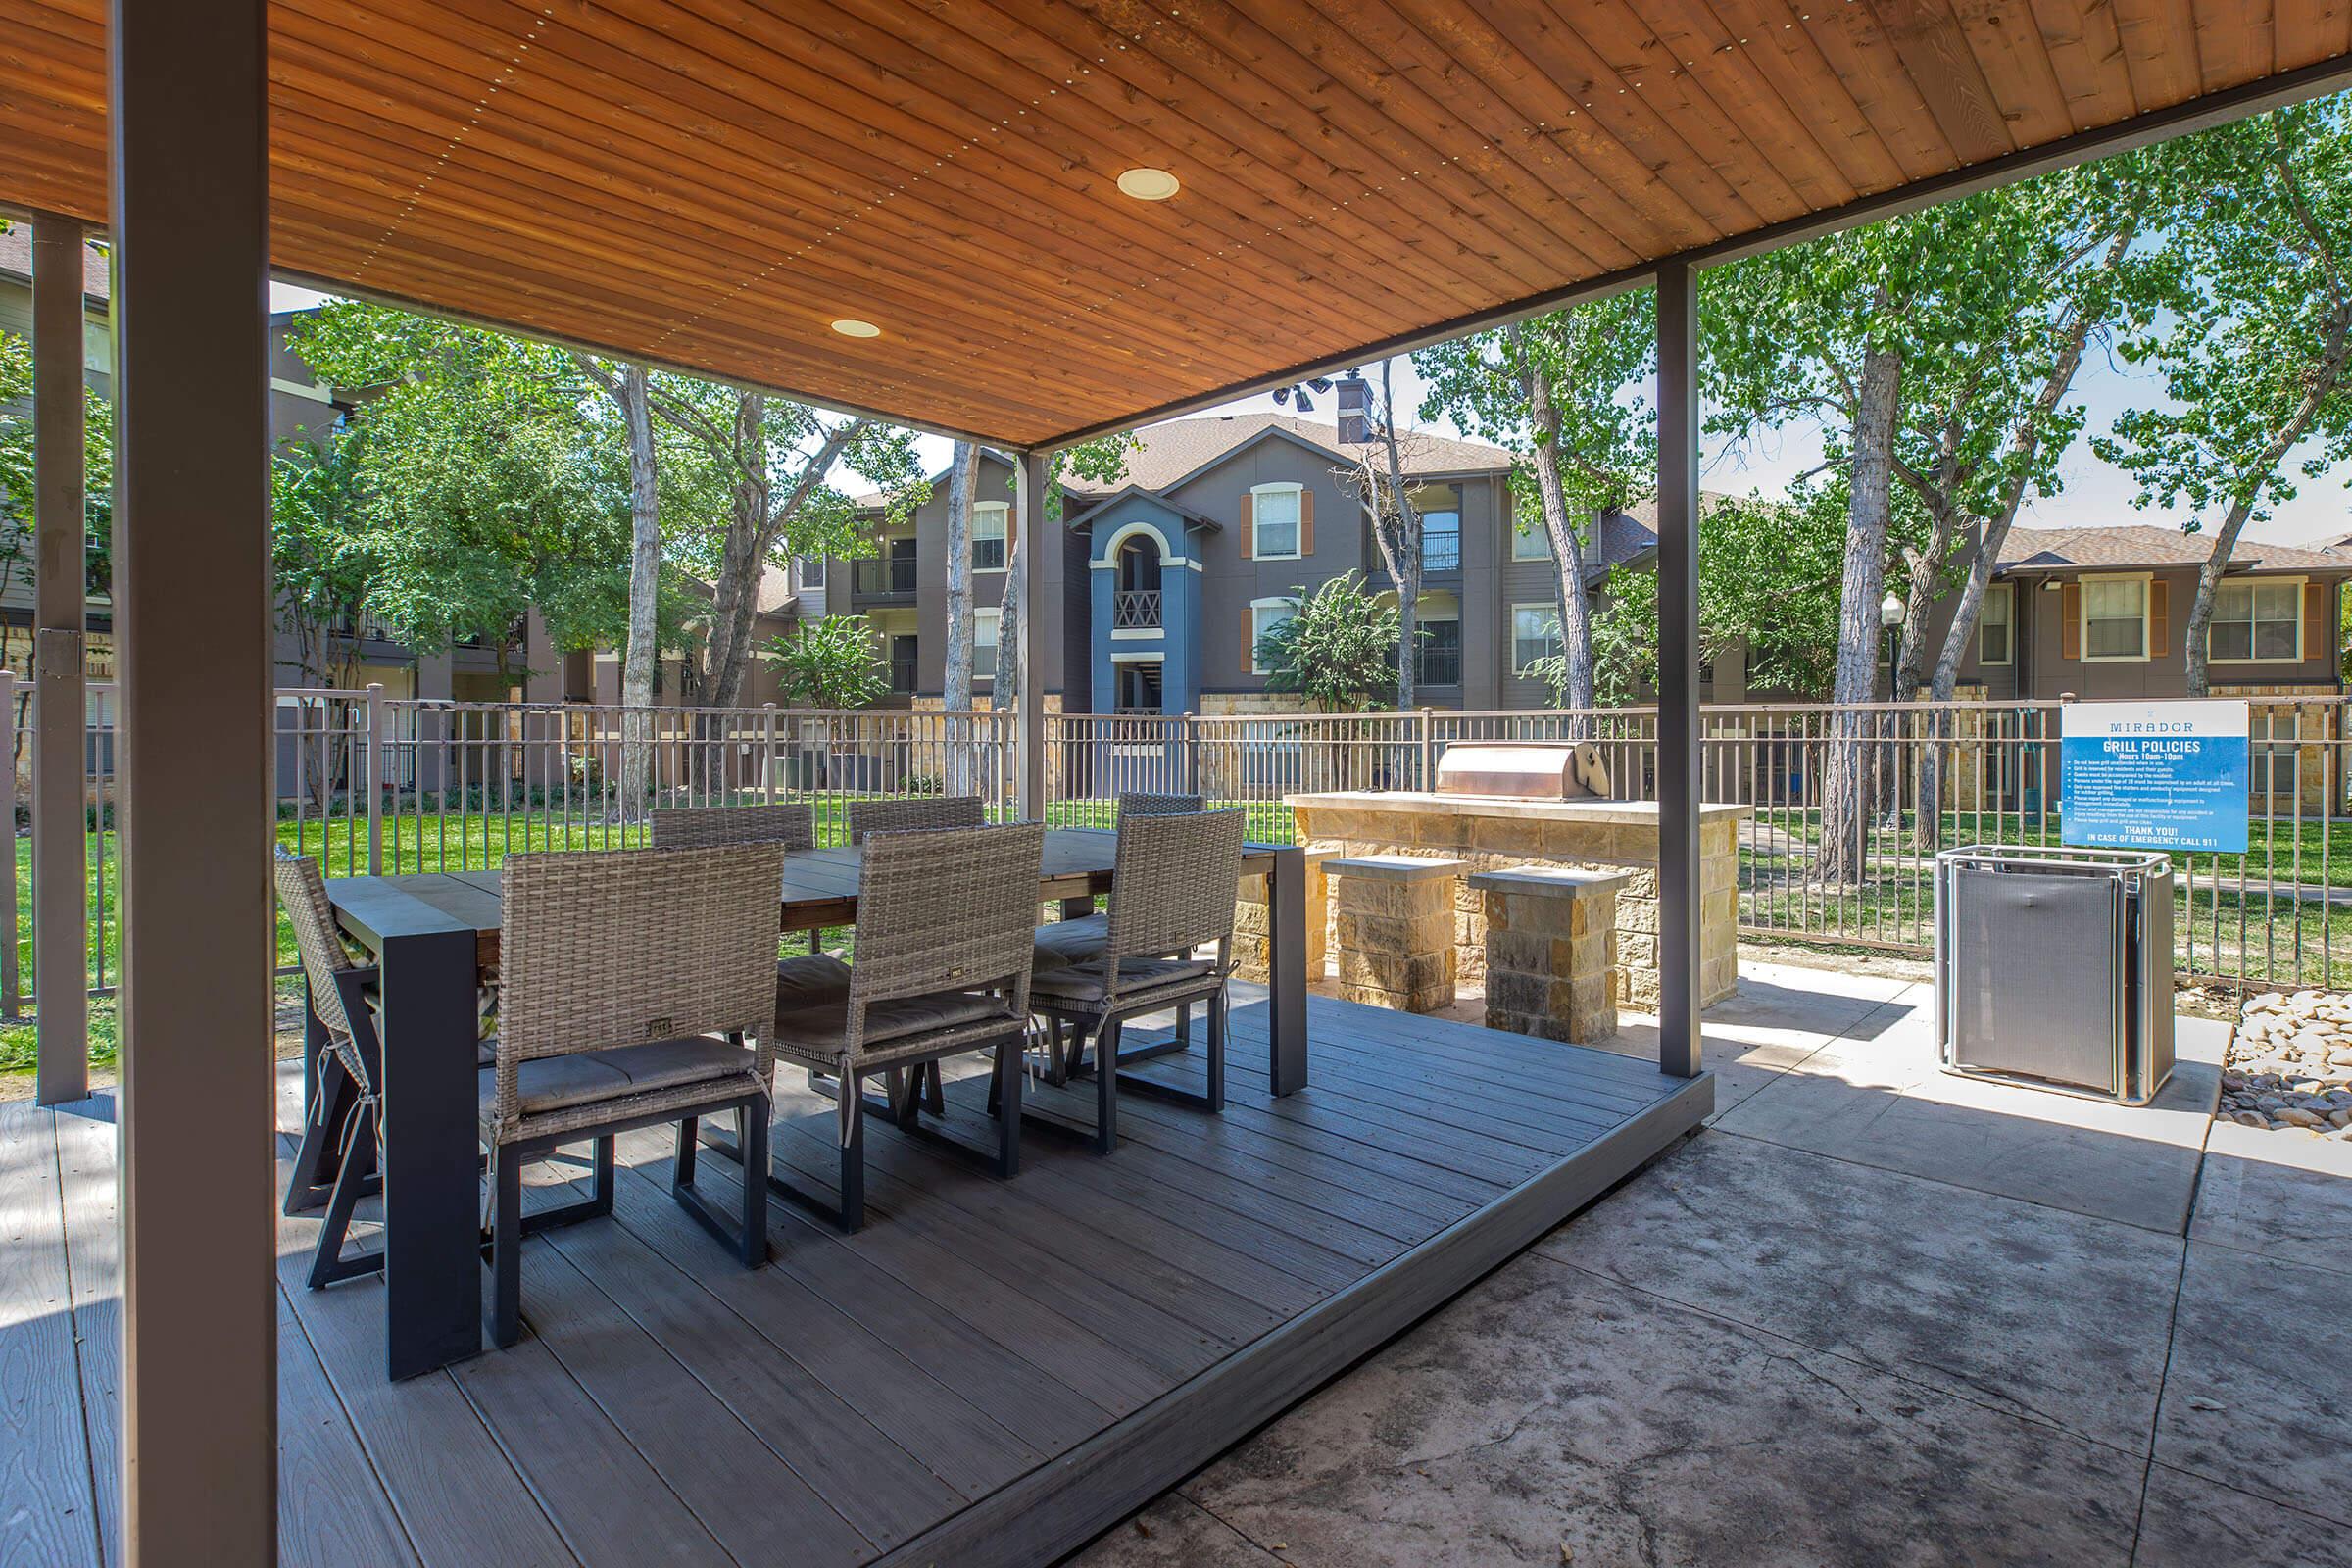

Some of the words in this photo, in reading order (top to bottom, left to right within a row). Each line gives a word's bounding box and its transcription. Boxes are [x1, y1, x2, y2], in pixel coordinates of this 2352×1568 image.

[2110, 722, 2193, 732] MIRADOR
[2103, 741, 2138, 752] GRILL
[2142, 741, 2200, 752] POLICIES
[2125, 825, 2153, 835] THANK
[2156, 827, 2178, 836] YOU!
[2131, 835, 2179, 845] EMERGENCY
[2181, 837, 2200, 846] CALL
[2202, 838, 2217, 847] 911
